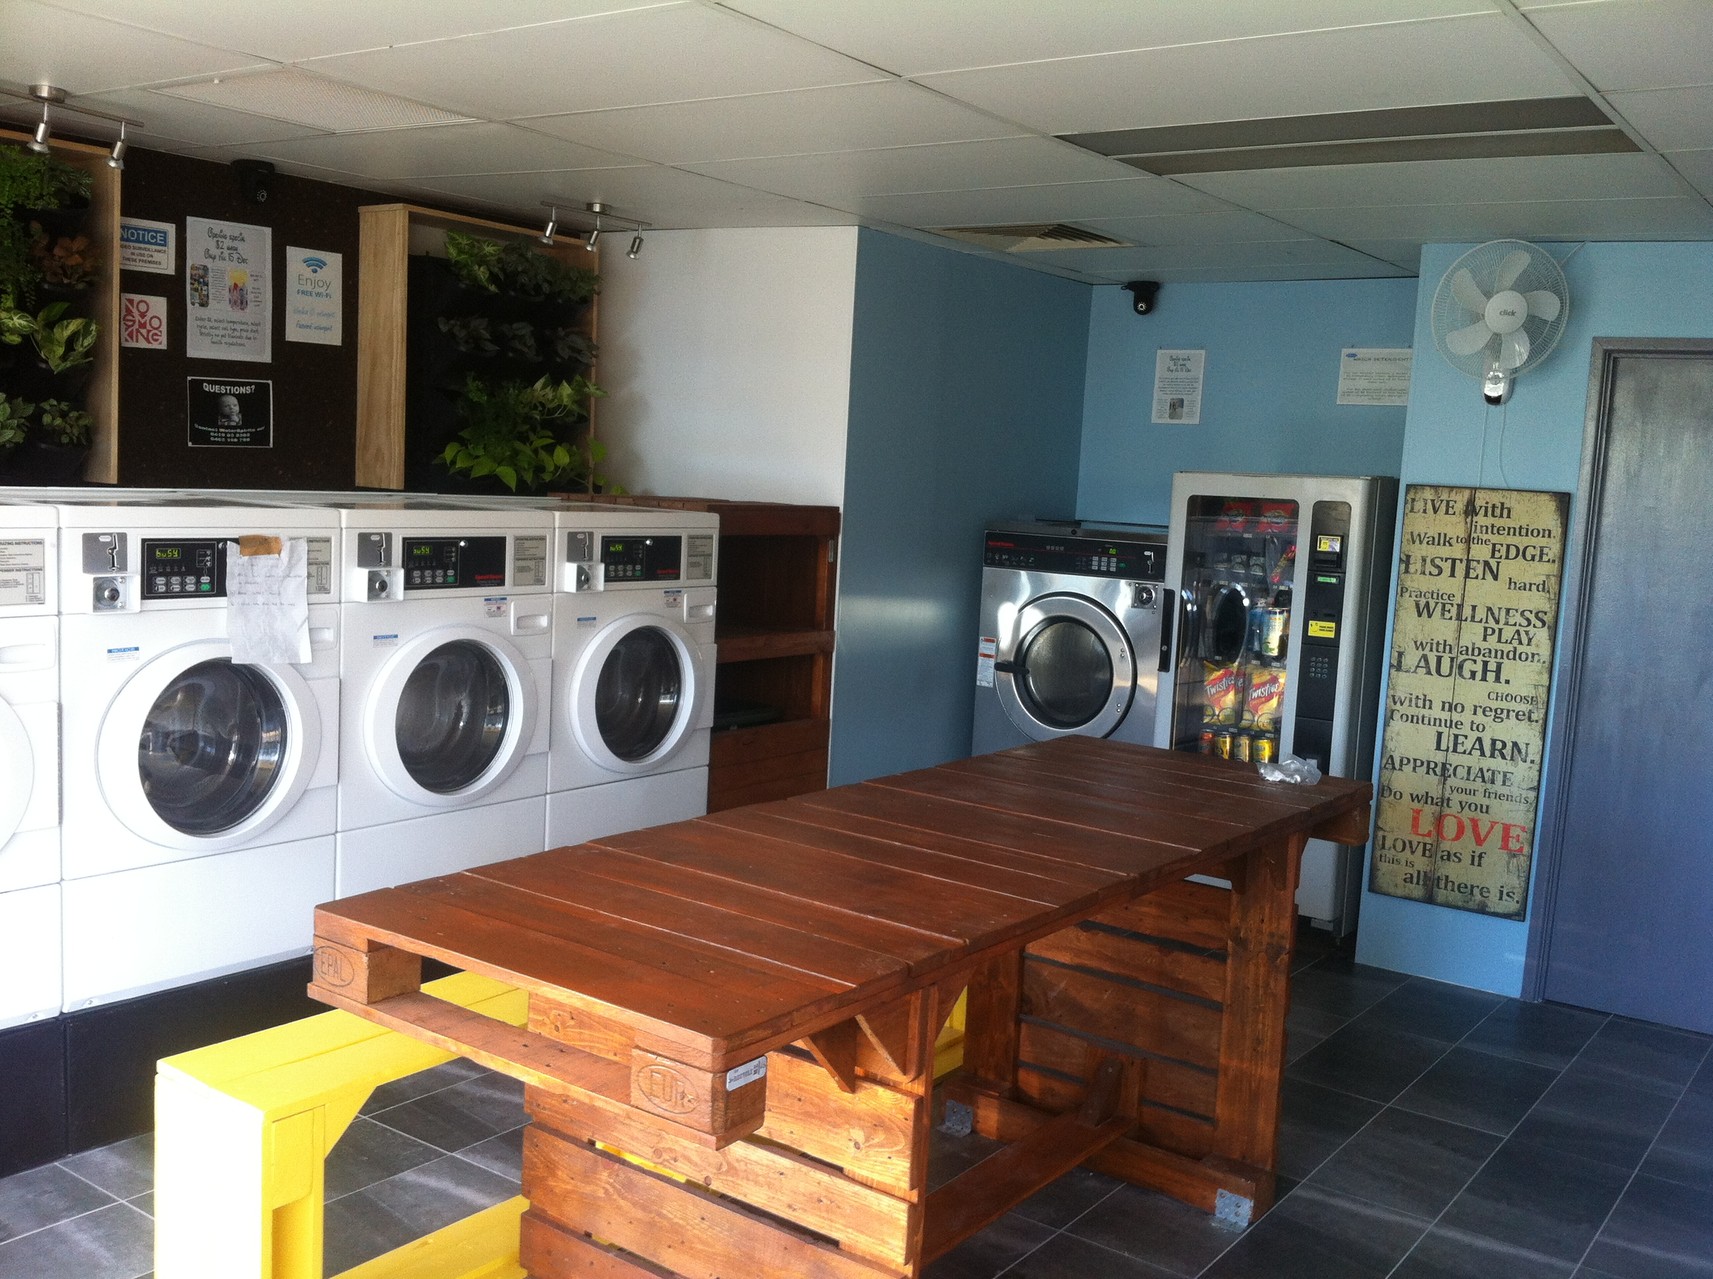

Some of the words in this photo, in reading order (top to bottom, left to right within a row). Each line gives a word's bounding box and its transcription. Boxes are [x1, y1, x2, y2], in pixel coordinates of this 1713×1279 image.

[121, 228, 165, 244] NOTICE
[297, 273, 332, 292] Enjoy
[296, 288, 313, 298] FREE
[1499, 310, 1517, 318] click
[203, 382, 256, 394] QUESTIONS?
[1409, 498, 1457, 516] LIVE
[1473, 521, 1556, 539] intention.
[1410, 531, 1454, 547] Walk
[1456, 535, 1467, 544] to
[1472, 535, 1491, 546] the
[1490, 542, 1556, 564] EDGE.
[1402, 555, 1501, 582] LISTEN
[1400, 586, 1455, 602] Practice
[1507, 577, 1550, 593] hard.
[1413, 638, 1454, 655] with
[1482, 626, 1537, 647] PLAY
[1394, 651, 1511, 685] LAUGH.
[1391, 693, 1433, 711] with
[1440, 700, 1465, 714] no
[1471, 704, 1539, 724] regret.
[1487, 691, 1538, 706] CHOOSE
[1390, 708, 1464, 730] Continue
[1470, 720, 1486, 733] to
[1434, 731, 1535, 764] LEARN.
[1383, 754, 1514, 788] APPRECIATE
[1381, 784, 1403, 801] Do
[1409, 791, 1453, 809] what
[1457, 800, 1490, 815] you
[1449, 784, 1479, 797] your
[1410, 807, 1528, 854] LOVE
[1379, 853, 1401, 867] this
[1405, 858, 1415, 868] is
[1380, 835, 1433, 859] LOVE
[1439, 849, 1462, 864] as
[1469, 850, 1486, 868] if
[1403, 870, 1430, 887] all
[1435, 874, 1491, 899] there
[1499, 886, 1520, 905] is.
[320, 950, 347, 983] EPAL
